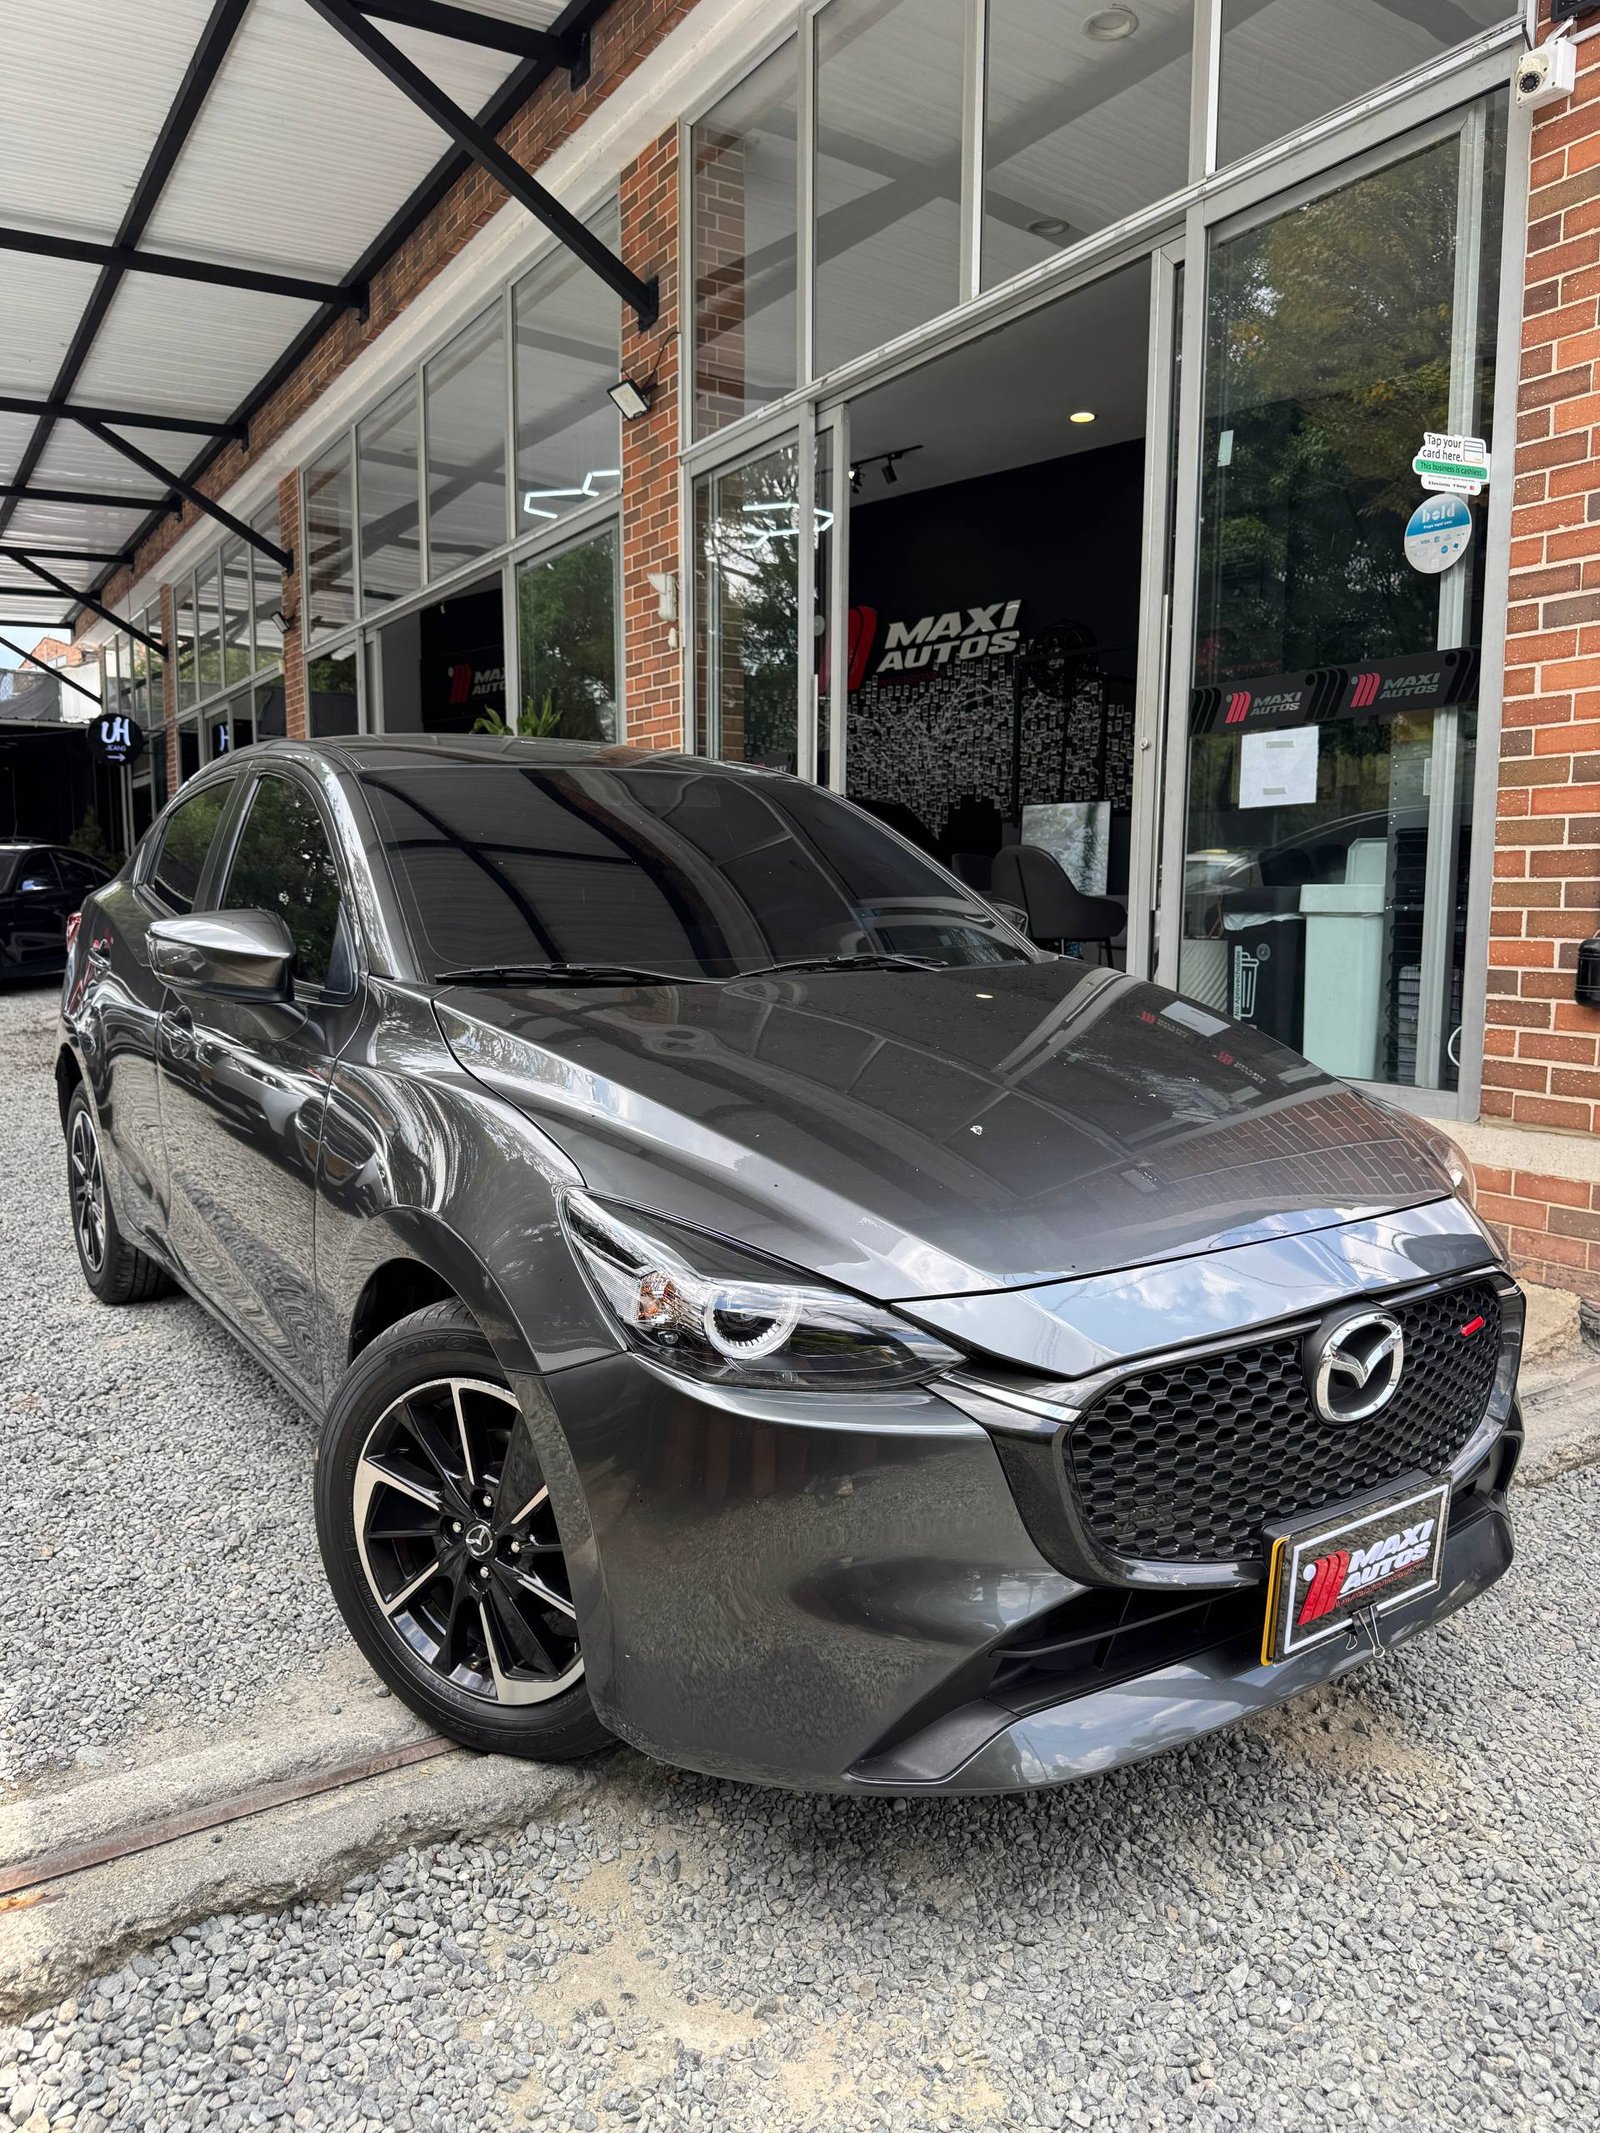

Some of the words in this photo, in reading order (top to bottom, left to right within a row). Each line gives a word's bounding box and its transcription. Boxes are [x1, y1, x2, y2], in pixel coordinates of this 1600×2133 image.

[1427, 435, 1441, 448] Tap
[1443, 438, 1461, 449] your
[1422, 449, 1440, 459] card
[1443, 450, 1463, 462] here.
[1420, 461, 1432, 470] This
[1432, 463, 1455, 473] business
[1422, 503, 1456, 523] bold
[884, 599, 1022, 650] MAXI
[876, 630, 1020, 673] AUTOS
[1383, 672, 1441, 690] MAXI
[1253, 691, 1302, 708] MAXI
[1380, 684, 1439, 700] AUTOS
[1250, 702, 1301, 717] AUTOS
[101, 716, 131, 747] UH
[105, 744, 127, 752] JEANS
[1347, 1519, 1435, 1573] MAXI
[1340, 1541, 1431, 1594] AUTOS
